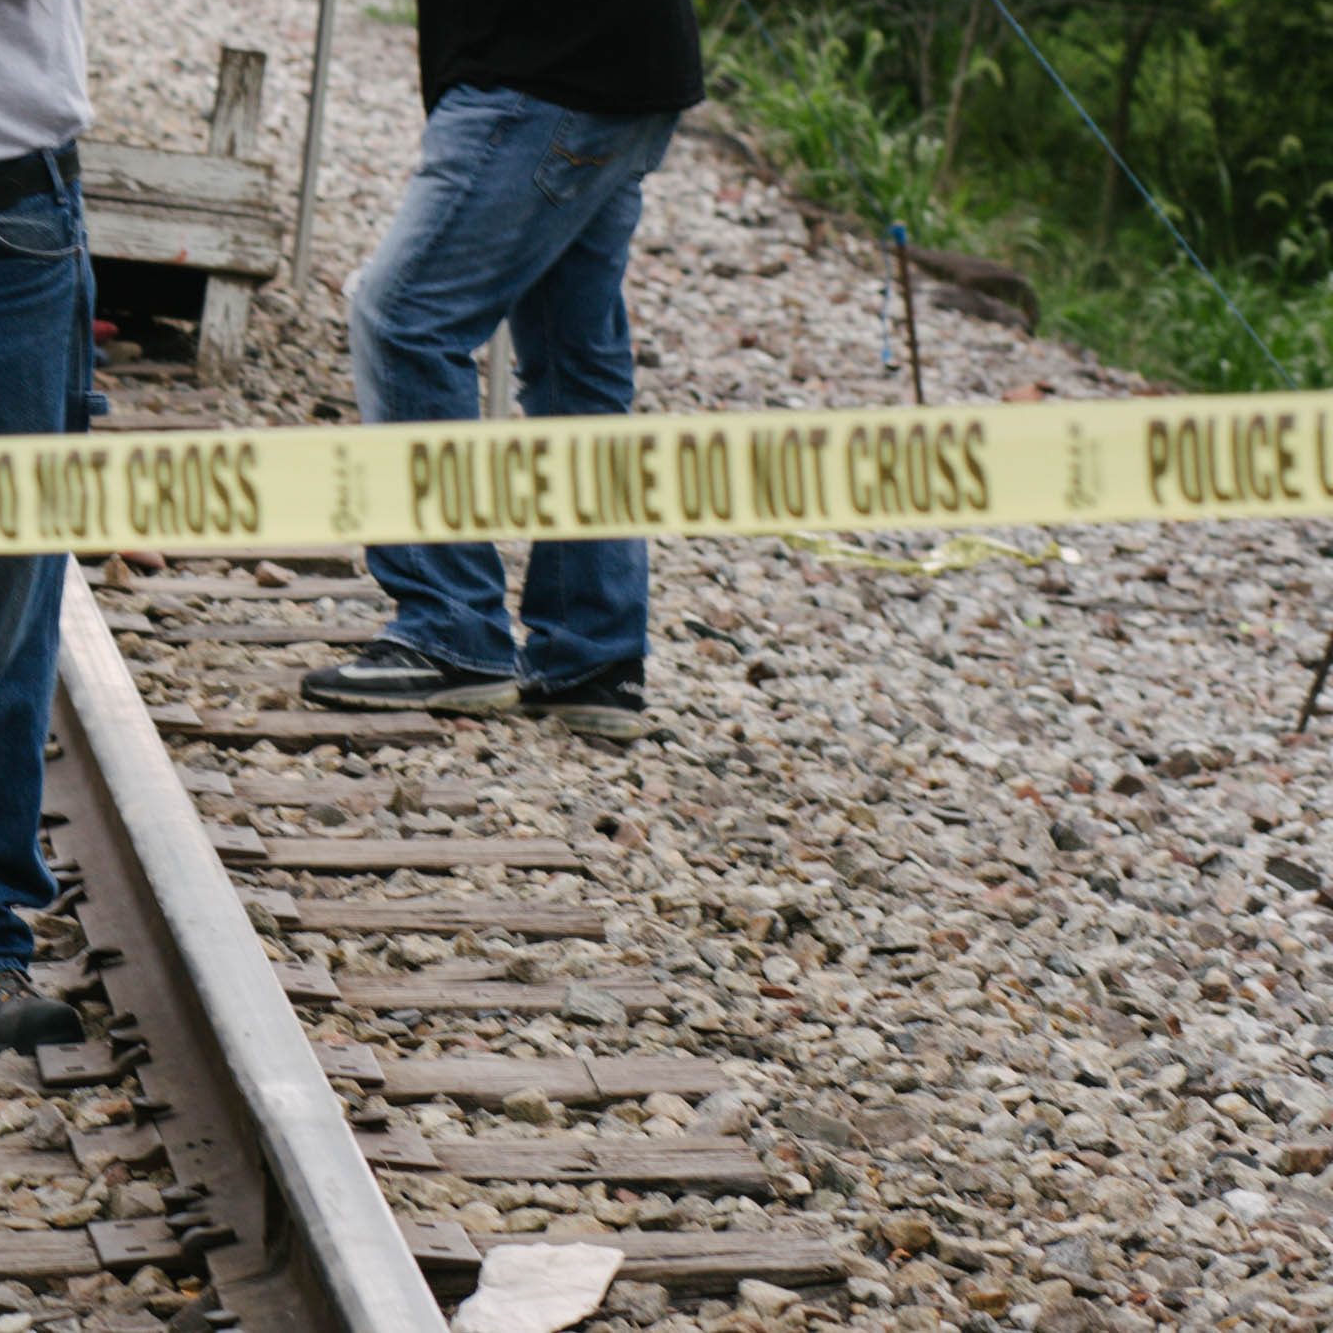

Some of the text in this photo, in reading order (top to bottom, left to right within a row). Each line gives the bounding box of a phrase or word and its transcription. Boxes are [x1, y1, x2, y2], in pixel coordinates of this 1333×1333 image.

[33, 449, 109, 539] NOT
[125, 442, 260, 536] CROSS
[410, 438, 556, 532] POLICE
[570, 434, 663, 527] LINE
[676, 431, 733, 522] DO
[749, 428, 829, 519] NOT
[846, 421, 989, 516] CROSS
[1147, 413, 1303, 505] POLICE
